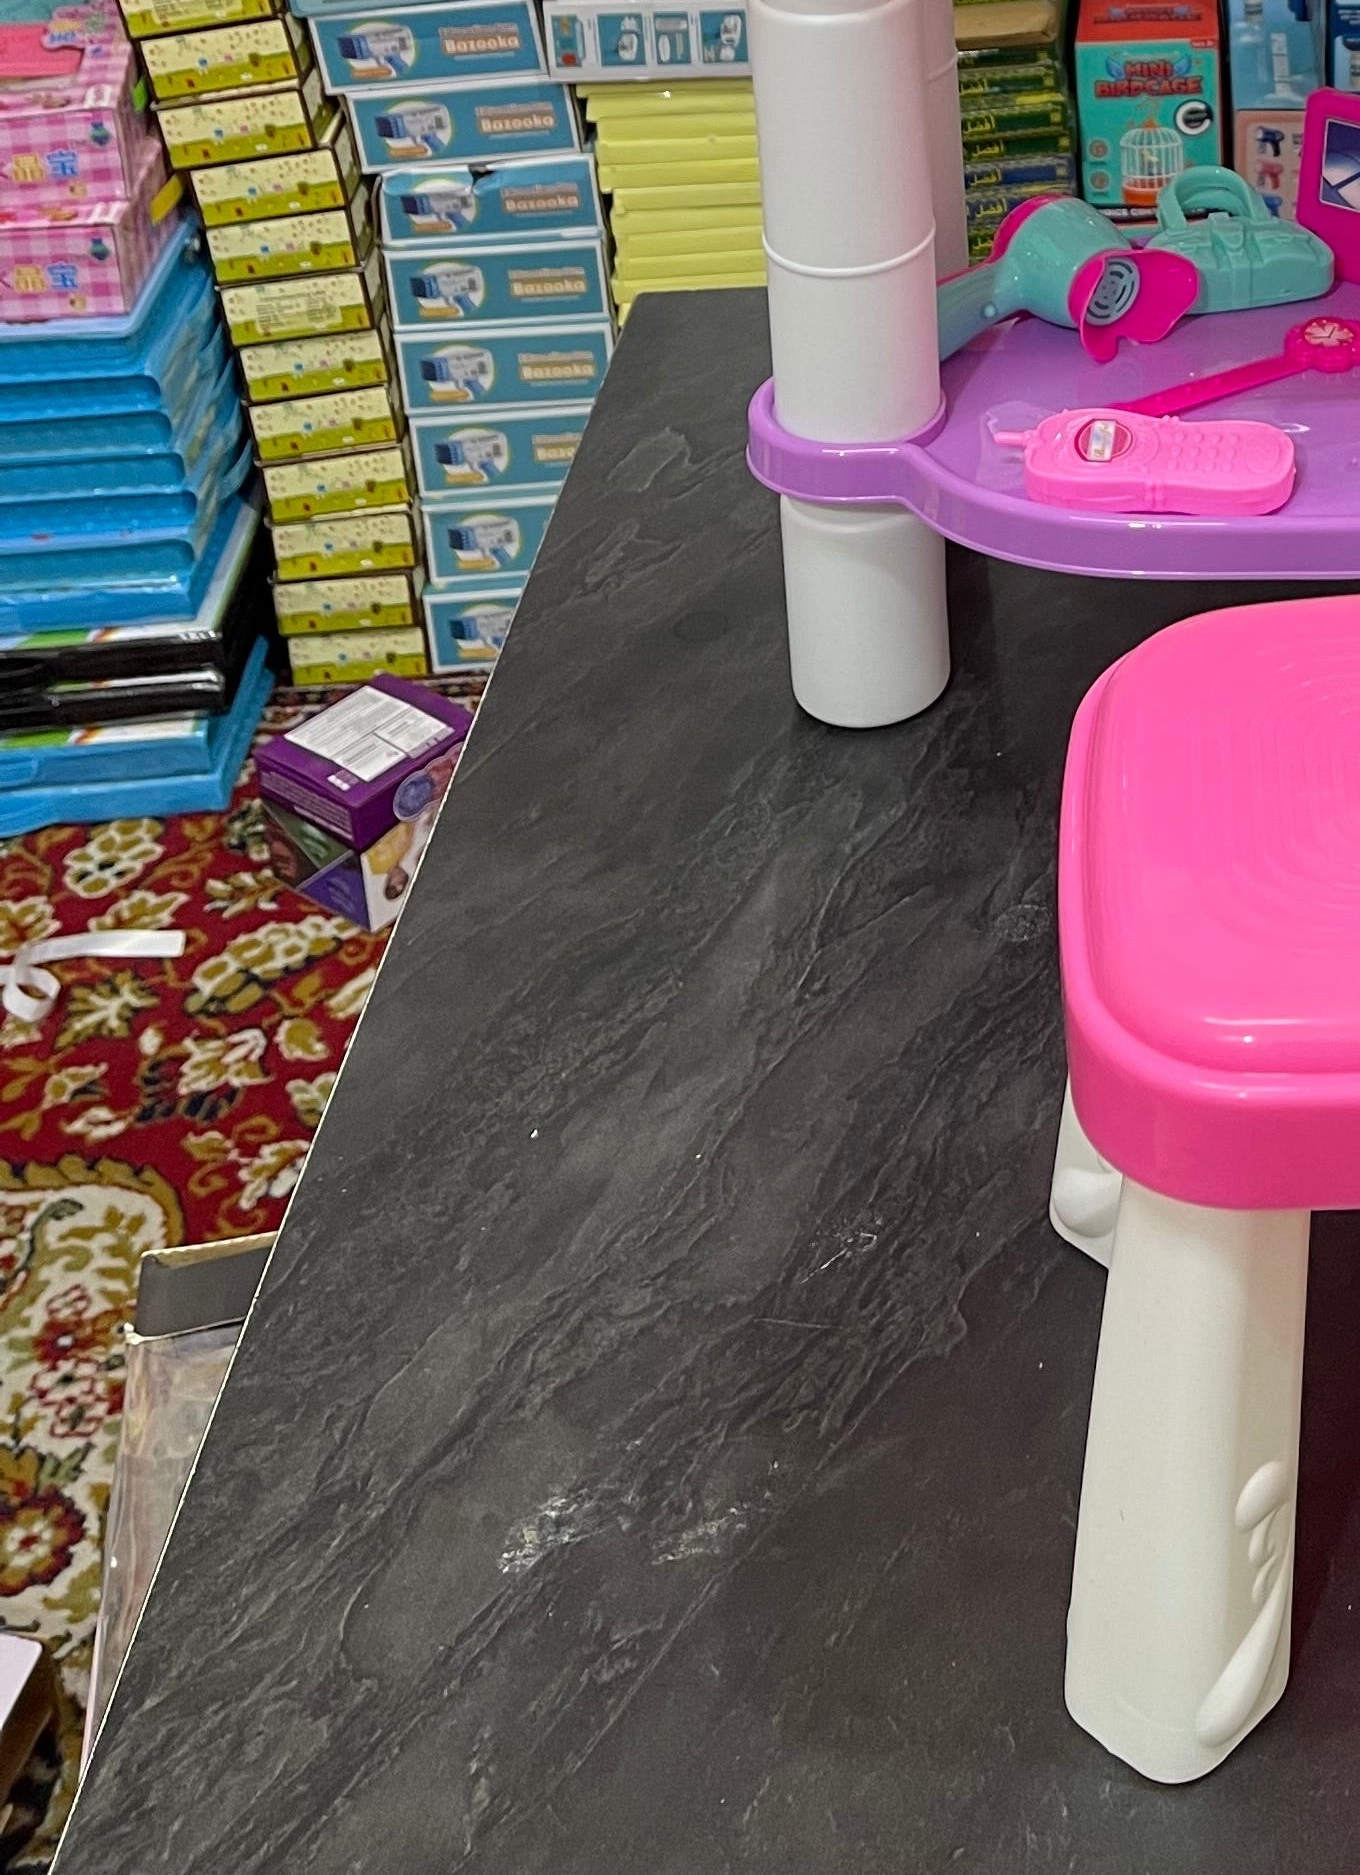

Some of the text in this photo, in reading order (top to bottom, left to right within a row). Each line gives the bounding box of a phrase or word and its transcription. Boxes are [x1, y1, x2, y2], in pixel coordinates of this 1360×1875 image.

[444, 35, 520, 55] Bazooka
[1123, 60, 1174, 78] MINI
[480, 114, 554, 133] Bazooka
[504, 194, 578, 211] Bazooka
